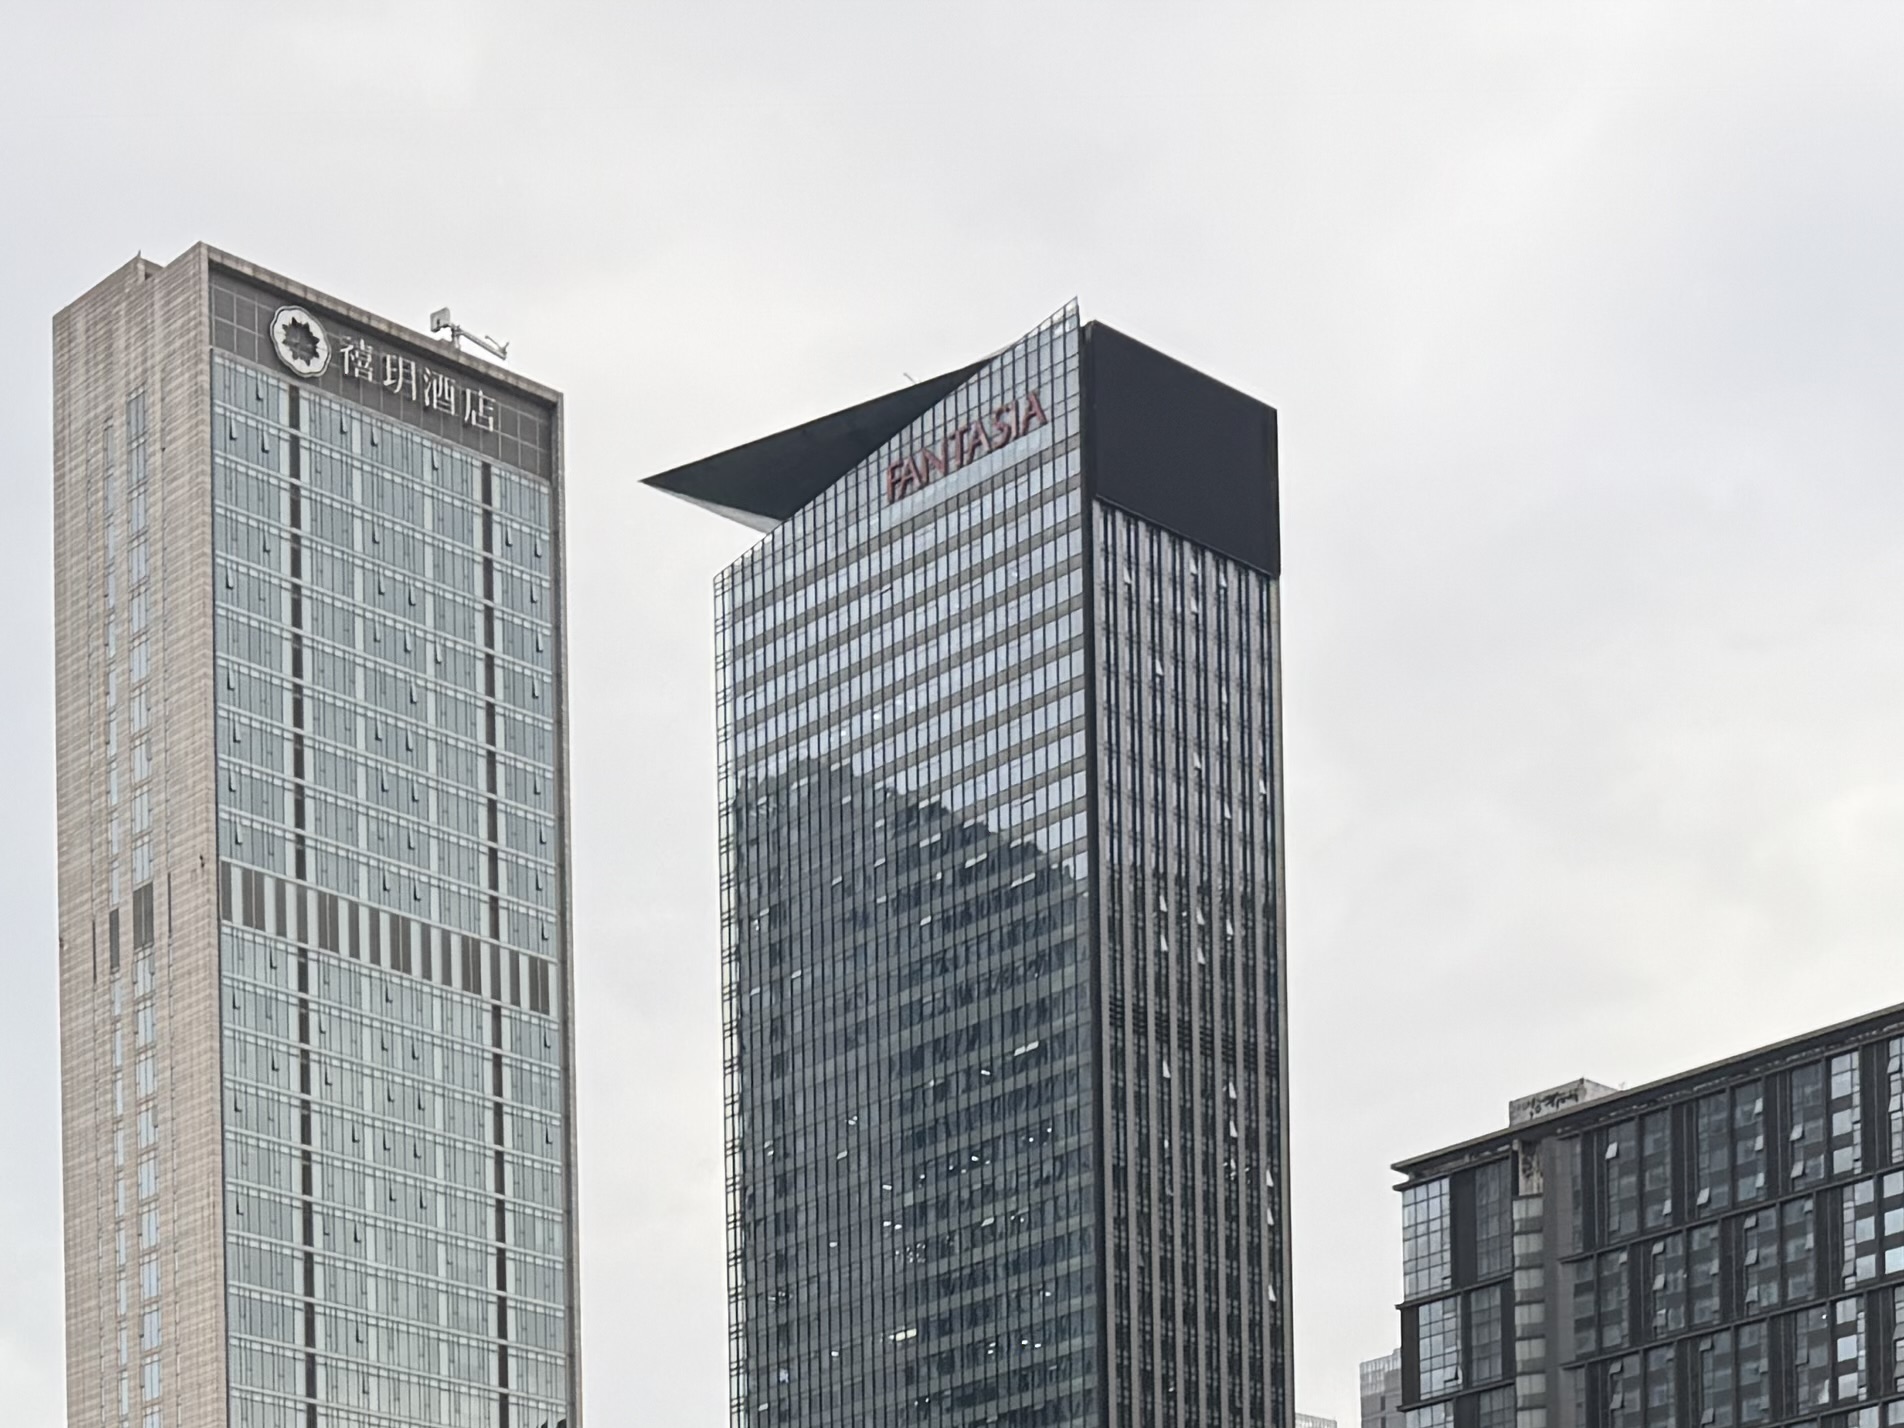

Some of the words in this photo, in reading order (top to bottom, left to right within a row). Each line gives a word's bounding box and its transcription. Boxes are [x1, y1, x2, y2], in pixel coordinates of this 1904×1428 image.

[340, 336, 496, 432] 禧玥酒店
[886, 390, 1049, 505] FANTASIA
